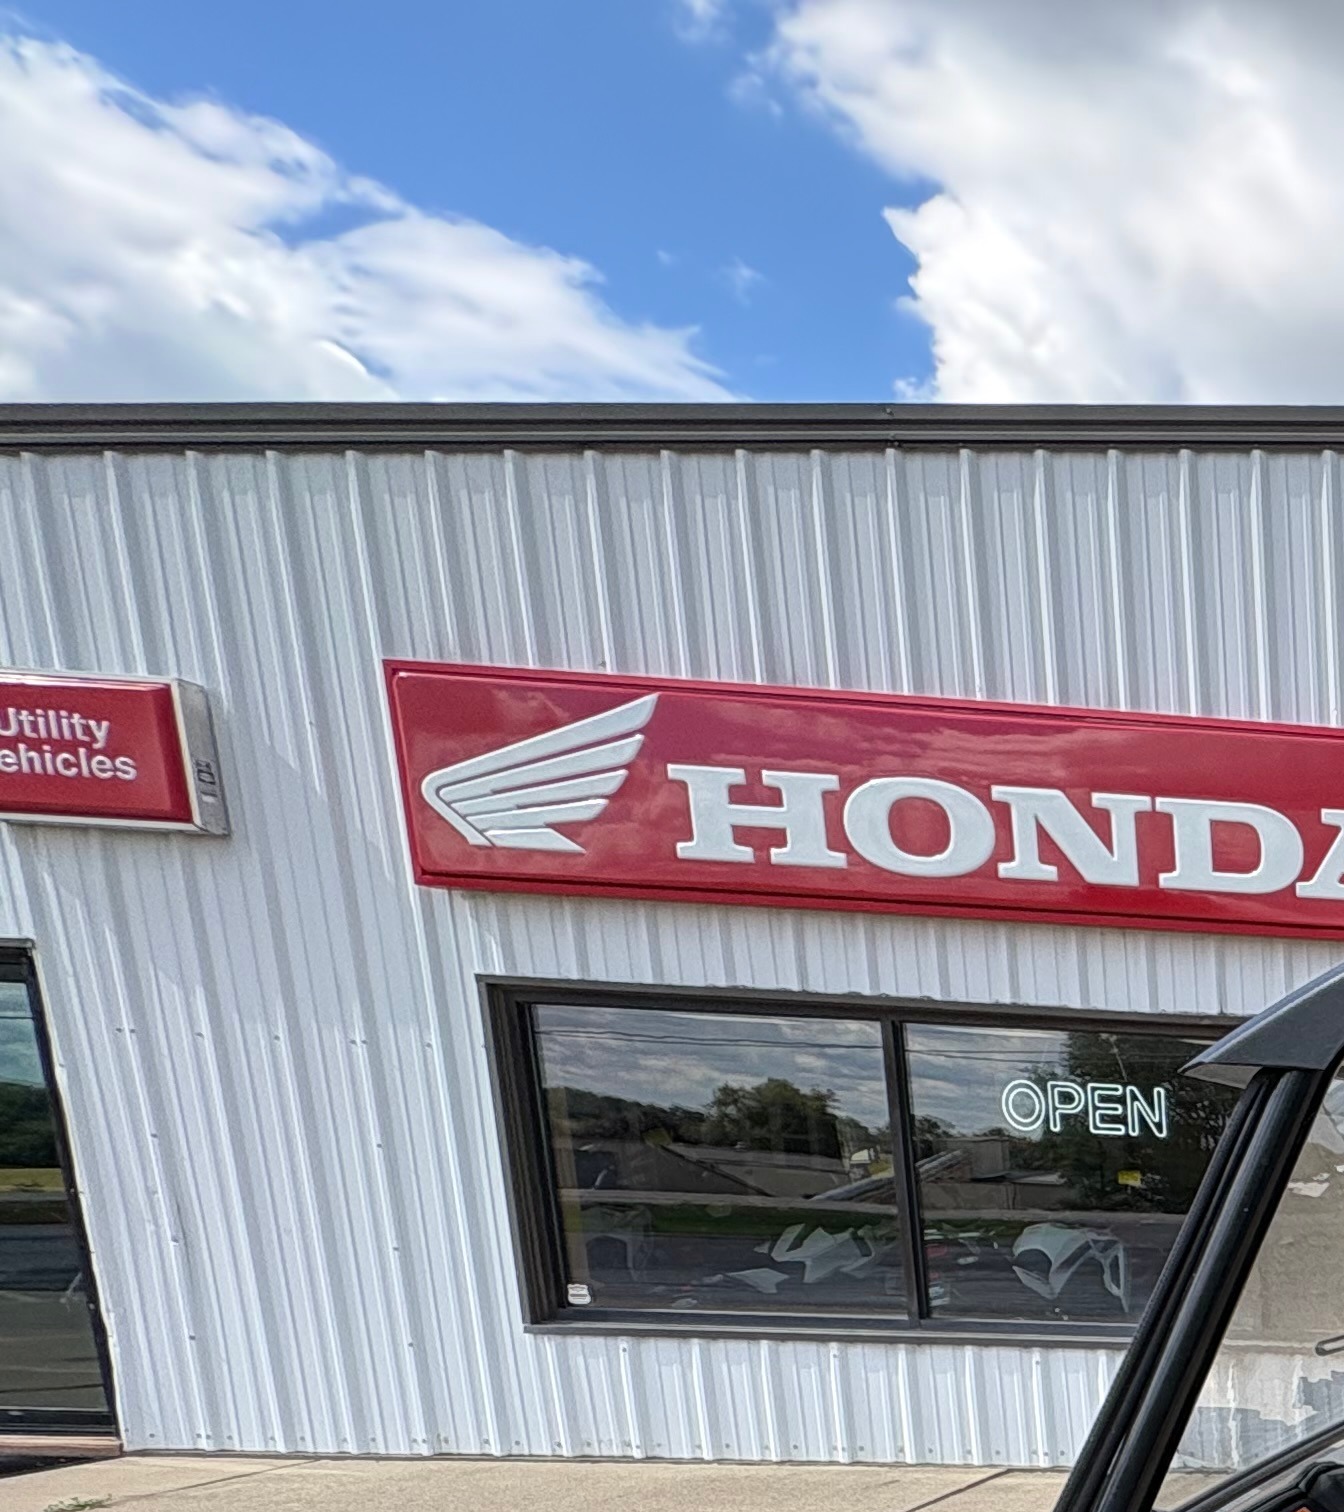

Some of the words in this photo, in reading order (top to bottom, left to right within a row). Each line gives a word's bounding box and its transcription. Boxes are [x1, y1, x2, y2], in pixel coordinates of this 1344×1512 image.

[0, 707, 110, 749] Utility
[0, 743, 137, 780] ehicles
[1002, 1080, 1167, 1138] OPEN
